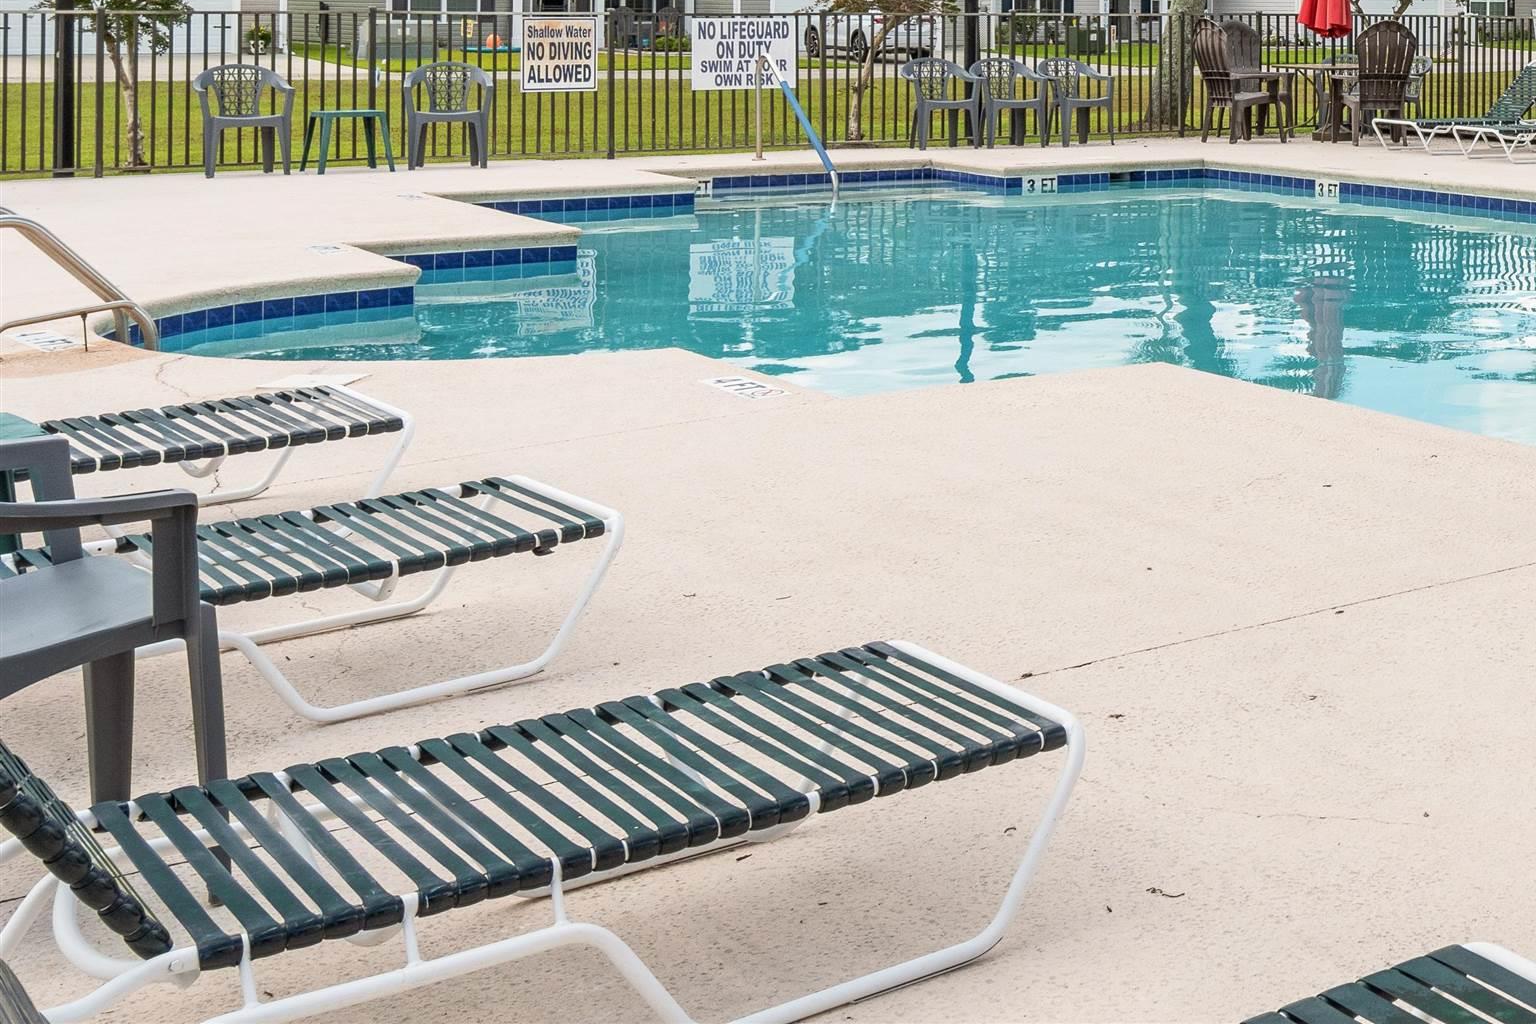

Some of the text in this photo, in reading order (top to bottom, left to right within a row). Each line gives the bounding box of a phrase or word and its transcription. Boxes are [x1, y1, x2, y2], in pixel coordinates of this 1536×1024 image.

[527, 25, 591, 38] Shallow Water
[698, 21, 789, 40] NO LIFEGUARD
[527, 41, 592, 61] NO DIVING
[716, 41, 771, 59] ON DUTY
[527, 64, 592, 83] ALLOWED
[700, 60, 732, 73] SWIM
[736, 60, 751, 73] AT
[714, 74, 742, 86] OWN
